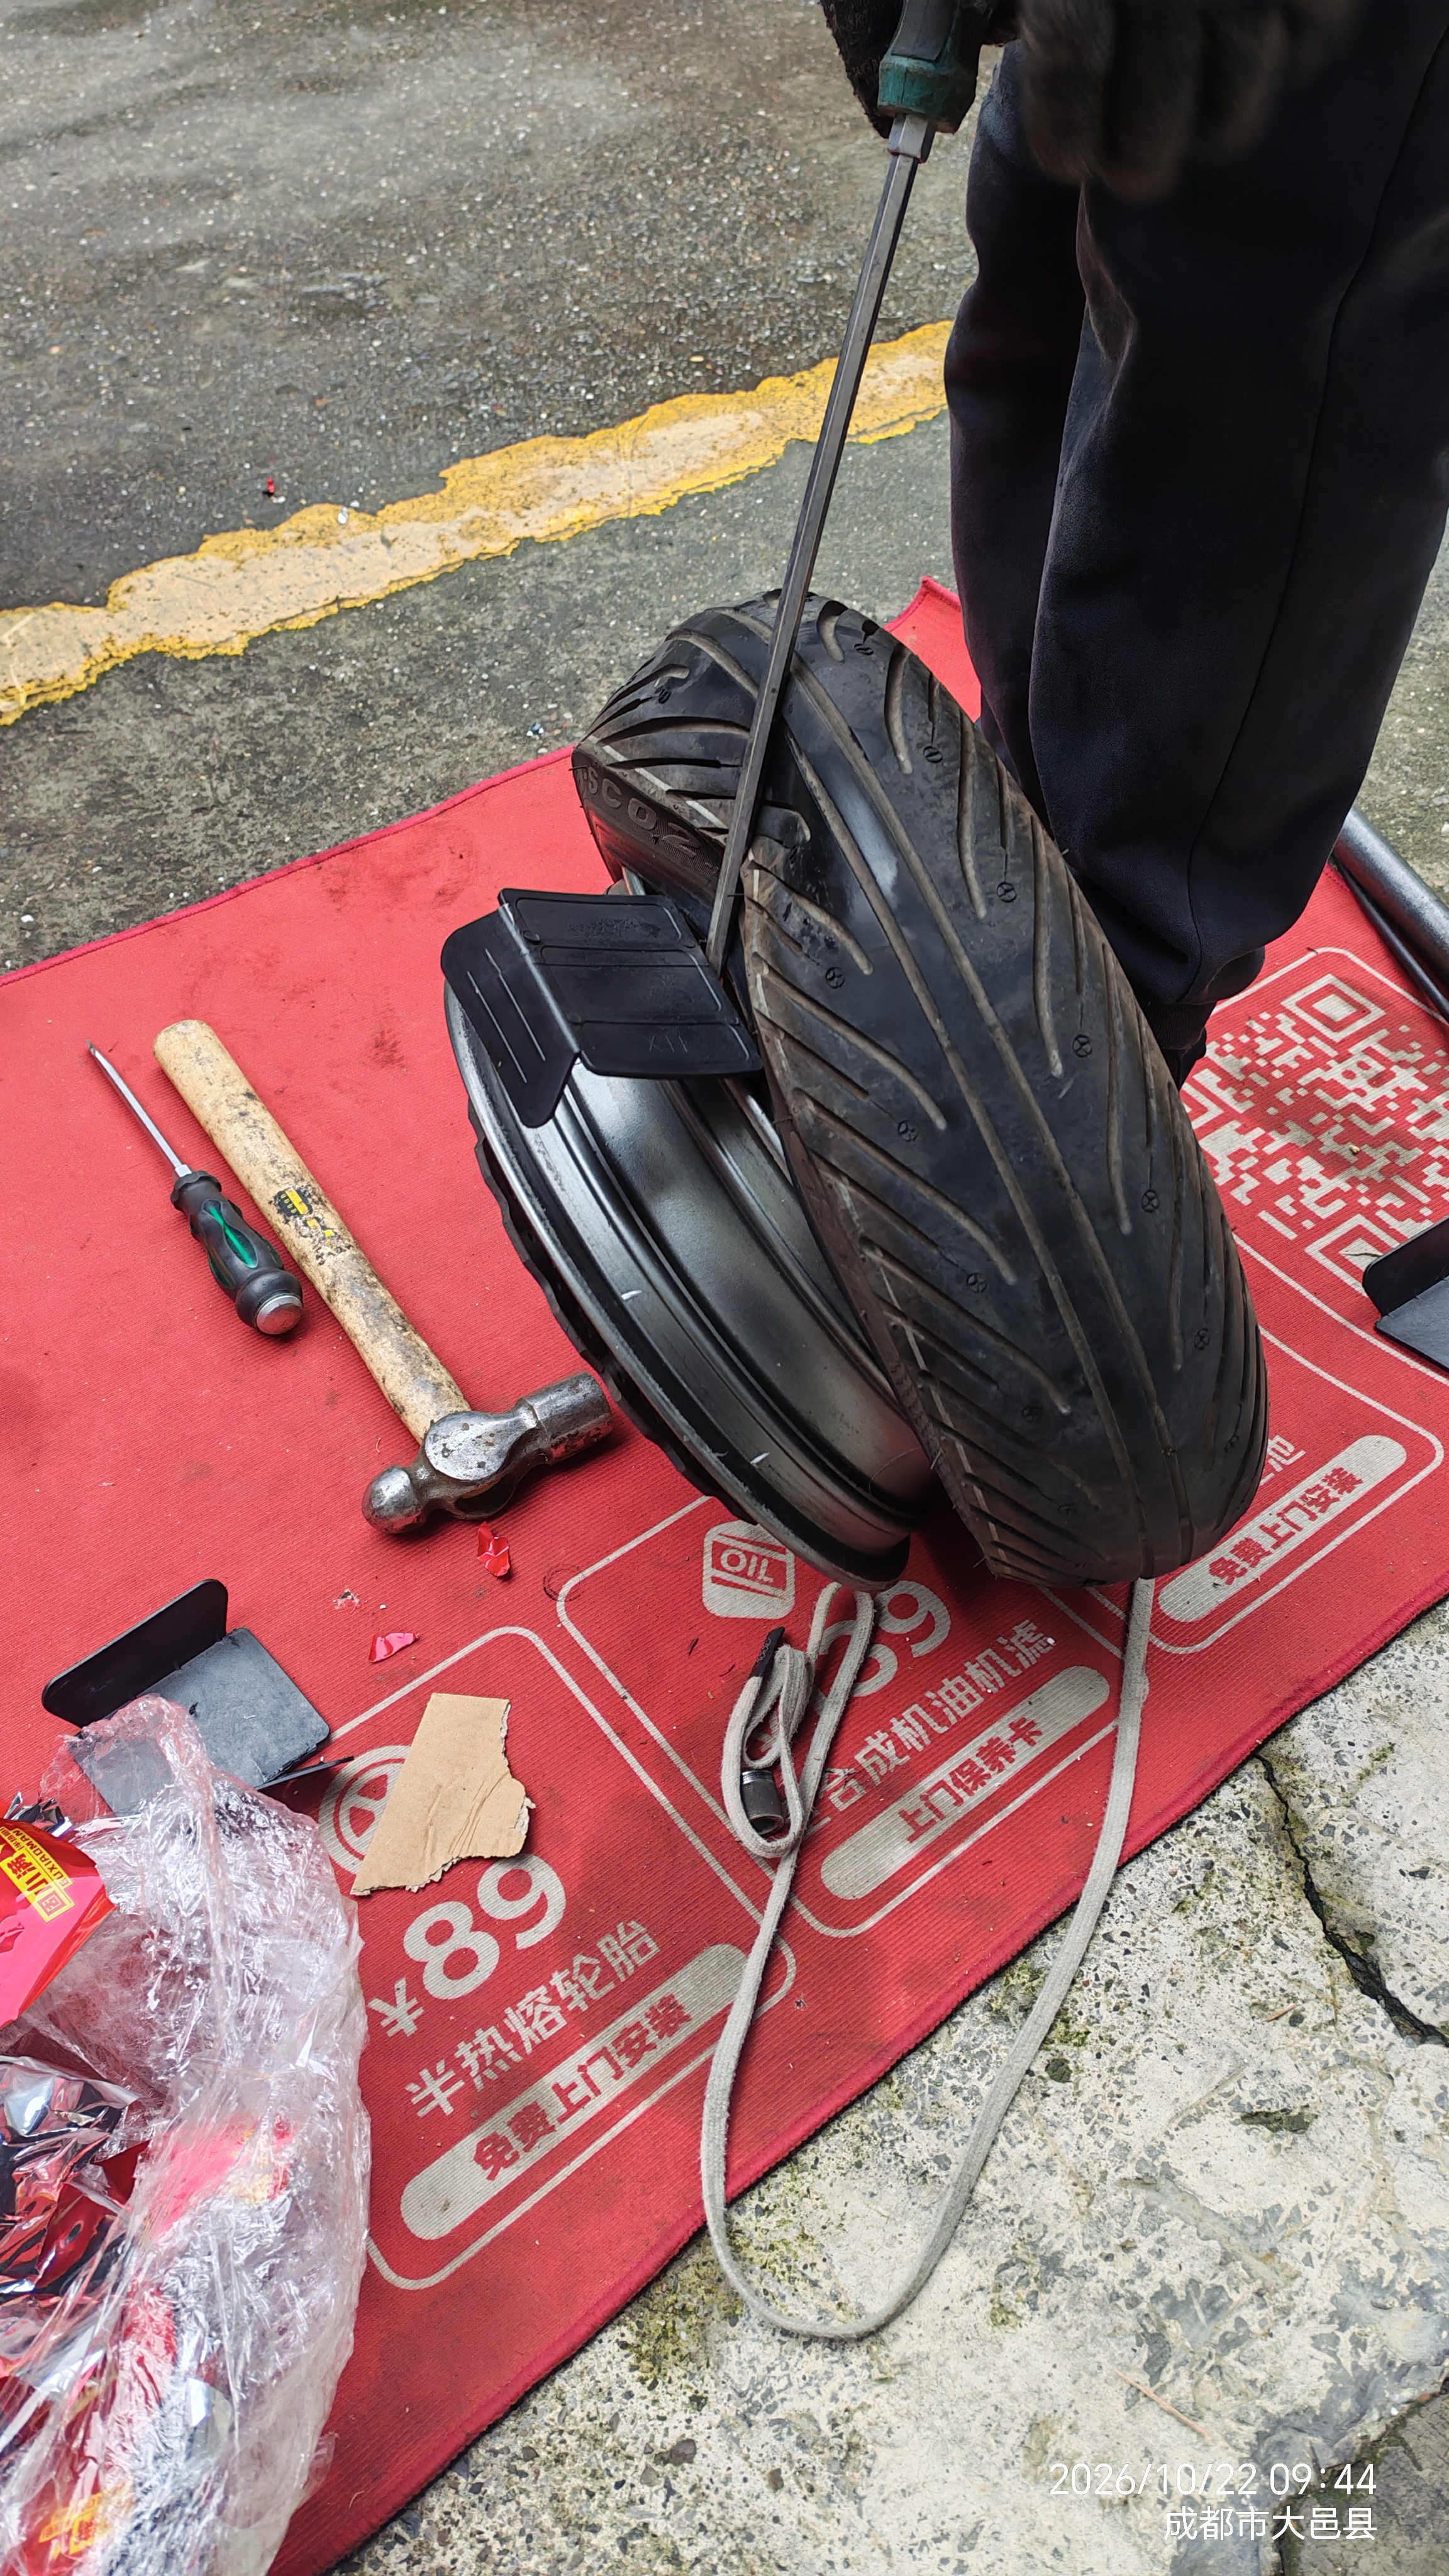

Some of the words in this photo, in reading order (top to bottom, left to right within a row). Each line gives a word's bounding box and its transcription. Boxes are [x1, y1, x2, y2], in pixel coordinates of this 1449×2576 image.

[720, 1548, 774, 1583] OIL
[1209, 1467, 1363, 1585] 免费上门安装
[804, 1619, 1057, 1838] 合成机油机滤
[898, 1716, 1043, 1843] 上门保养卡
[13, 1829, 69, 1886] GUXIAOMAN
[367, 1853, 566, 2037] ¥89
[405, 1919, 661, 2117] 半热熔轮胎
[473, 1994, 692, 2181] 免费上门安装
